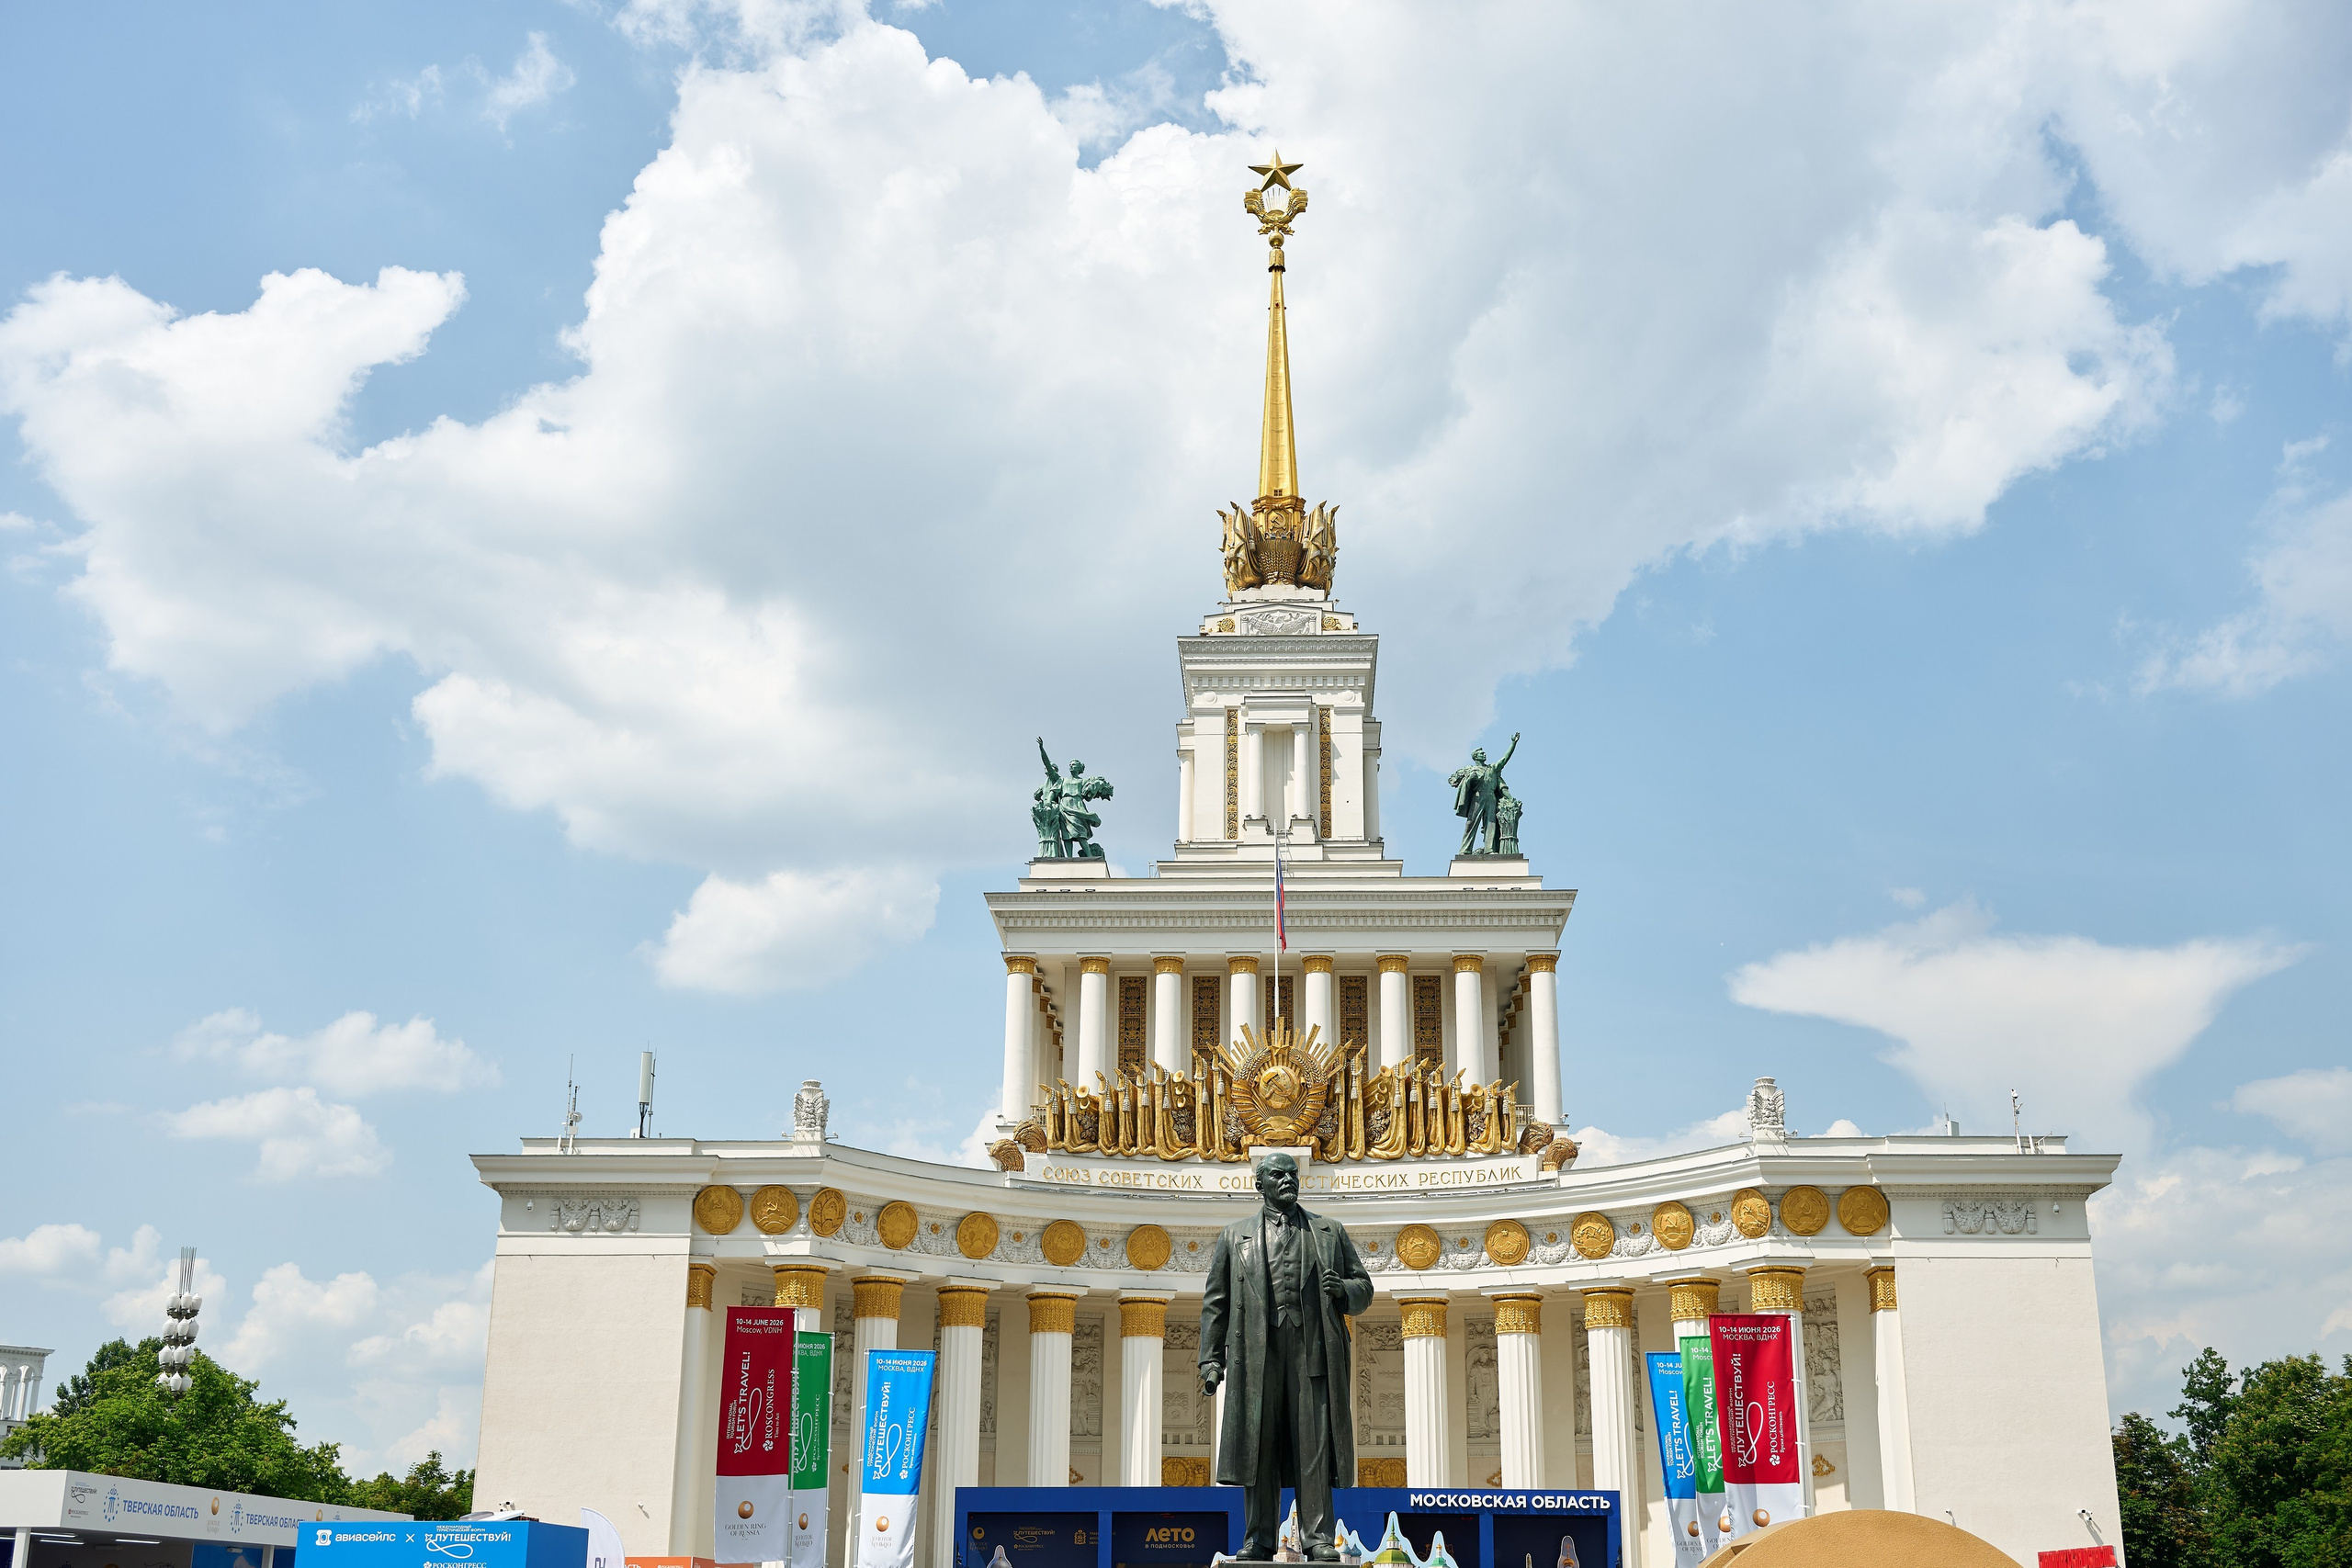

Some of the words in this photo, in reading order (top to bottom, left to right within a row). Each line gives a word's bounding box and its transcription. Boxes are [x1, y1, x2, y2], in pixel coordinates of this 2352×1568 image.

[1043, 1166, 1091, 1182] СОЮЗ
[1099, 1170, 1204, 1188] СОВЕТСКИХ
[1419, 1166, 1523, 1187] РЕСПУБЛИК
[736, 1325, 763, 1334] Moscow,
[739, 1351, 751, 1404] TRAVEL!
[765, 1369, 775, 1438] ROSCONGRESS
[1668, 1390, 1681, 1436] TRAVEL!
[1703, 1377, 1713, 1426] TRAVEL!
[1731, 1353, 1745, 1454] ПУТЕШЕСТВУЙ!
[1767, 1381, 1778, 1453] РОСКОНГРЕСС
[736, 1406, 747, 1439] LET'S
[875, 1381, 891, 1469] ПУТЕШЕСТВУЙ!
[902, 1406, 916, 1469] РОСКОНГРЕСС
[1674, 1438, 1684, 1467] LET'S
[1706, 1428, 1716, 1459] LET'S
[123, 1499, 164, 1516] ТВЕРСКАЯ
[164, 1504, 198, 1519] ОБЛАСТЬ
[1410, 1494, 1527, 1508] МОСКОВСКАЯ
[1532, 1495, 1611, 1509] ОБЛАСТЬ
[246, 1514, 278, 1527] ТВЕРСКАЯ
[334, 1531, 396, 1542] авиасейлс
[434, 1531, 511, 1542] ПУТЕШЕСТВУЙ!
